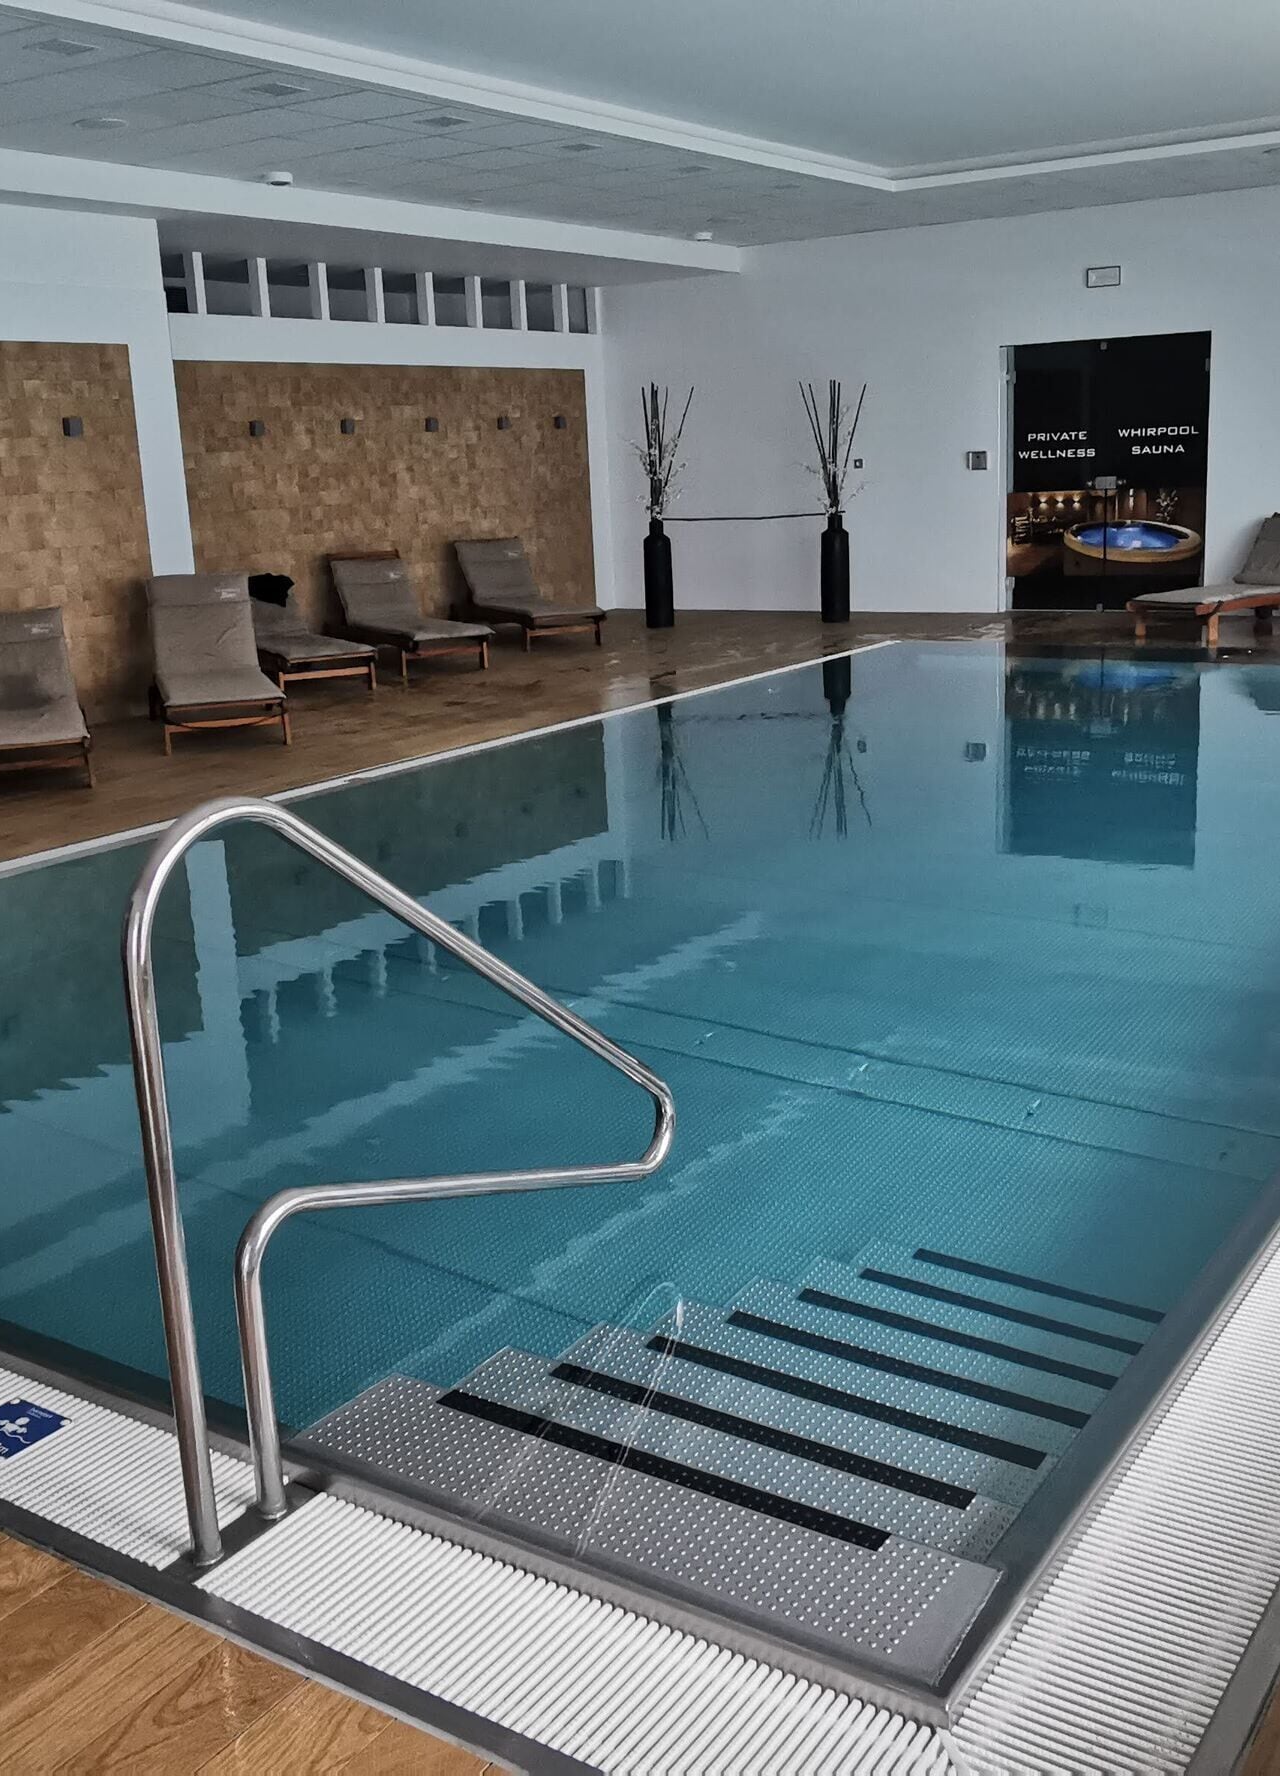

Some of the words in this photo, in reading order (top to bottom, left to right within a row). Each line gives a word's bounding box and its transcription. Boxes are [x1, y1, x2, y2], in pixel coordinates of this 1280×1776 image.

[1027, 431, 1088, 441] PRIVATE
[1118, 426, 1200, 437] WHIRPOOL
[1018, 448, 1096, 459] WELLNESS
[1131, 444, 1185, 455] SAUNA
